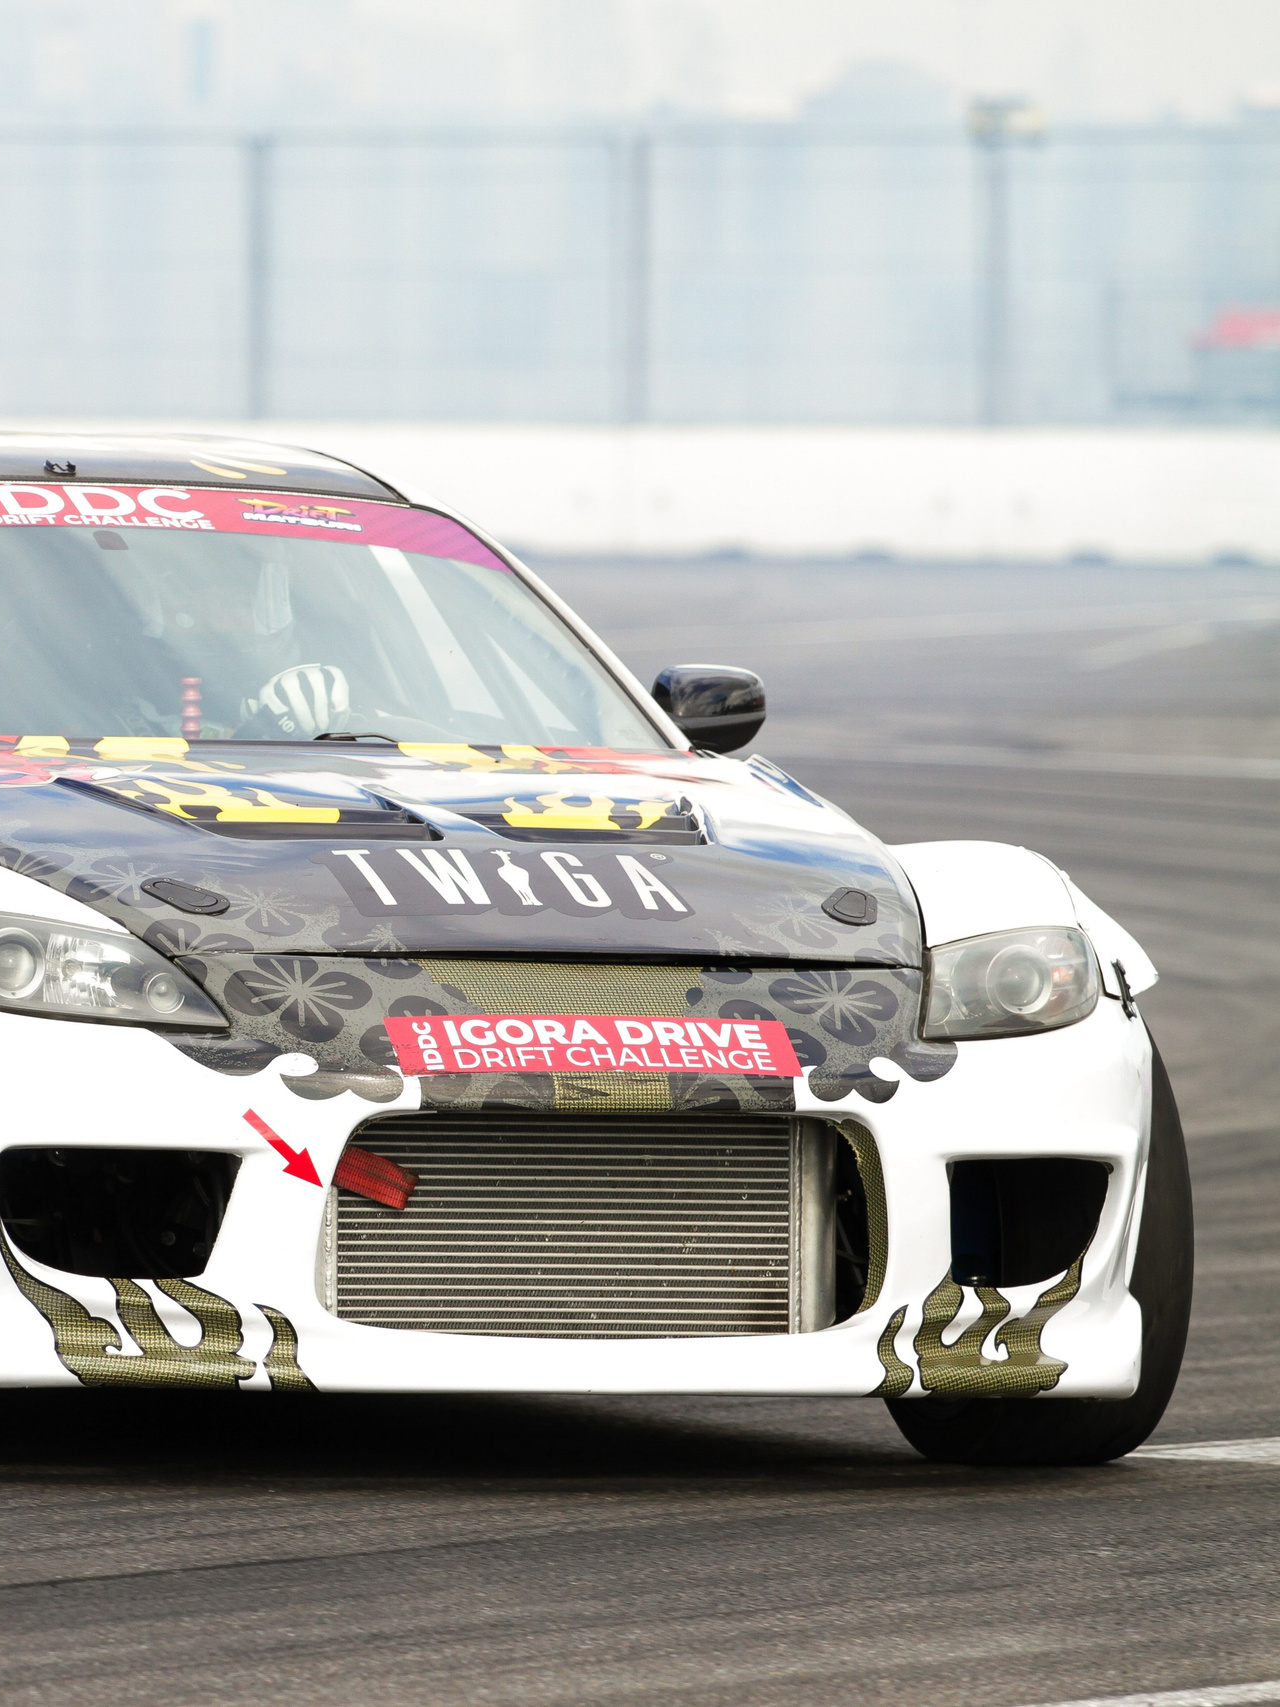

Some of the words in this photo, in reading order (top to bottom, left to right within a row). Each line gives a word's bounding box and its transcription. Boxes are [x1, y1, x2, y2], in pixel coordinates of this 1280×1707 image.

[63, 514, 216, 530] CHALLENGE
[412, 1021, 445, 1070] IDDC
[443, 1019, 609, 1046] IGORA
[613, 1020, 768, 1050] DRIVE
[453, 1046, 555, 1069] DRIFT
[565, 1046, 777, 1071] CHALLENGE
